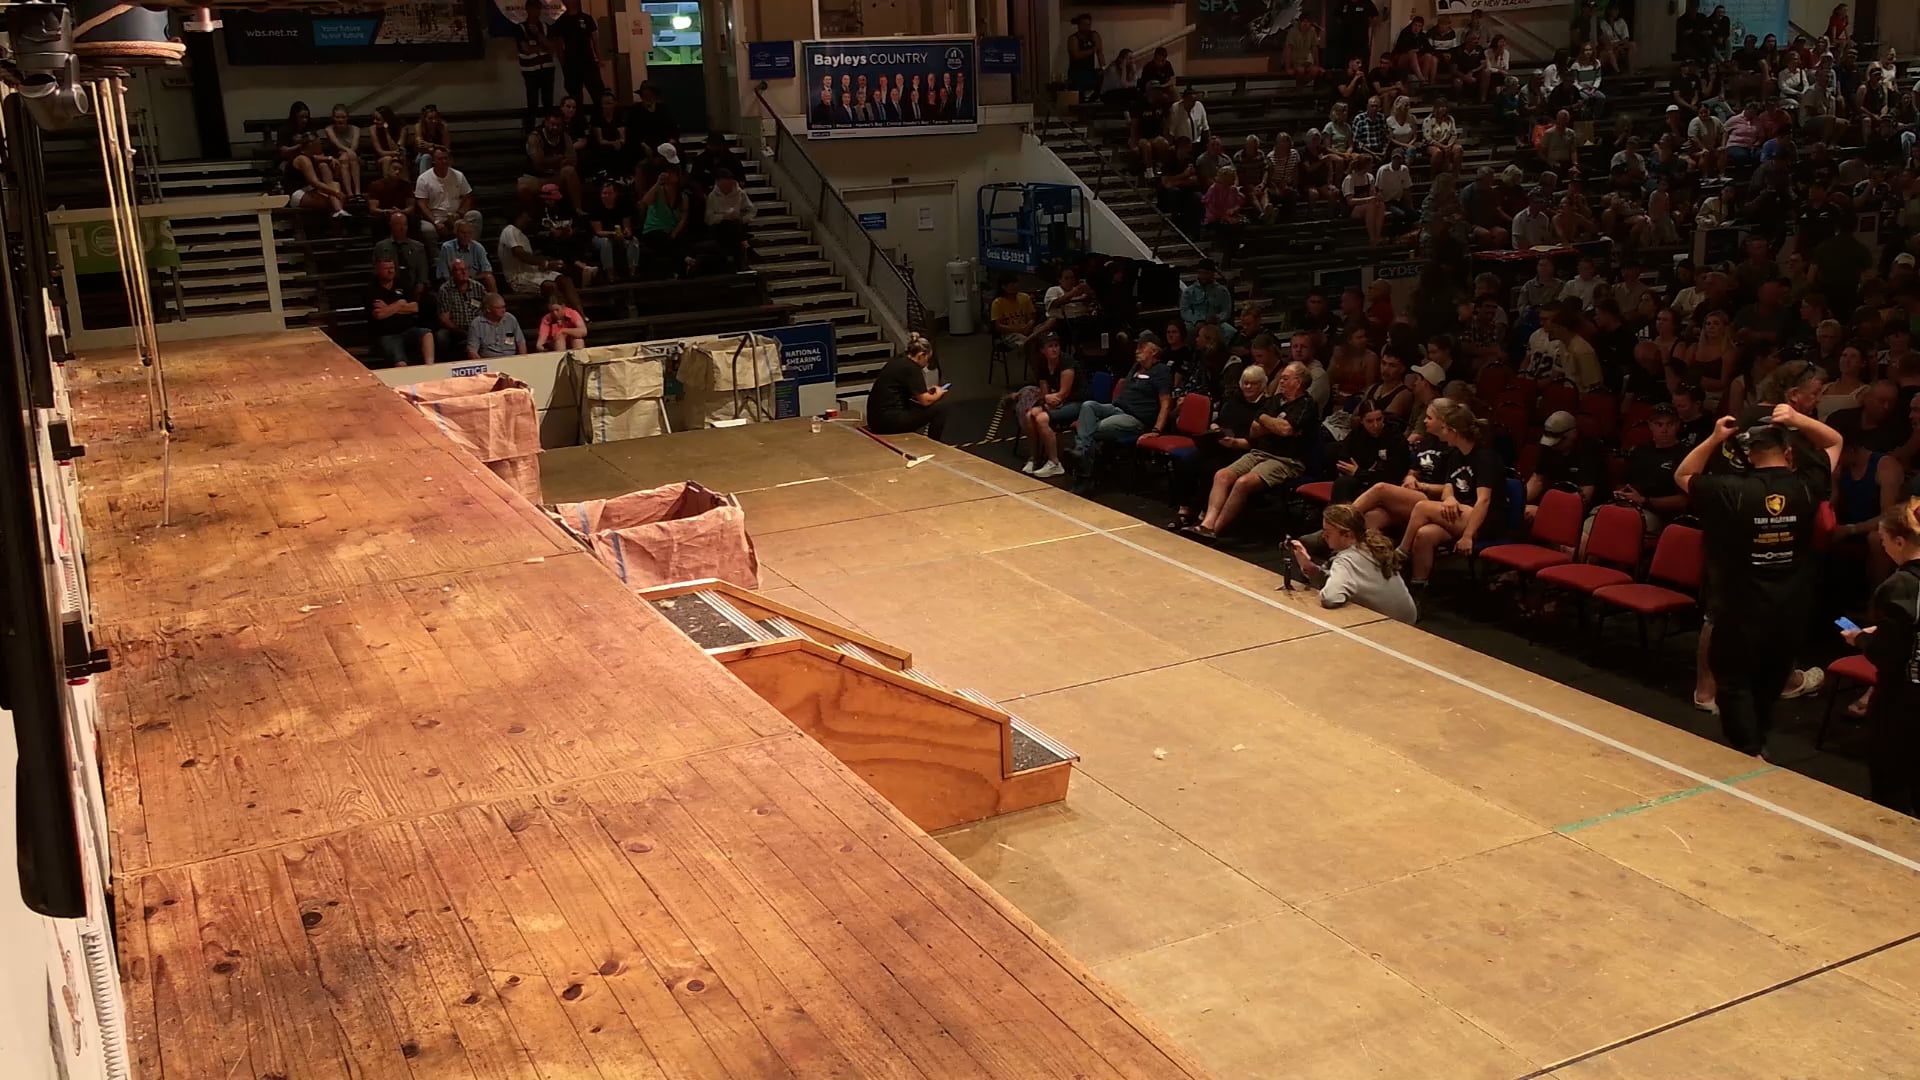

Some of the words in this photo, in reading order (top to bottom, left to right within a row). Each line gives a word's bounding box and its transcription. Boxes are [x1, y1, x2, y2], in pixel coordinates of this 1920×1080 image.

[246, 28, 299, 38] wbs.net.nz
[813, 53, 867, 67] Bayleys
[869, 52, 929, 65] COUNTRY
[785, 347, 822, 358] NATIONAL
[785, 355, 821, 364] SHEARING
[453, 366, 487, 375] NOTICE
